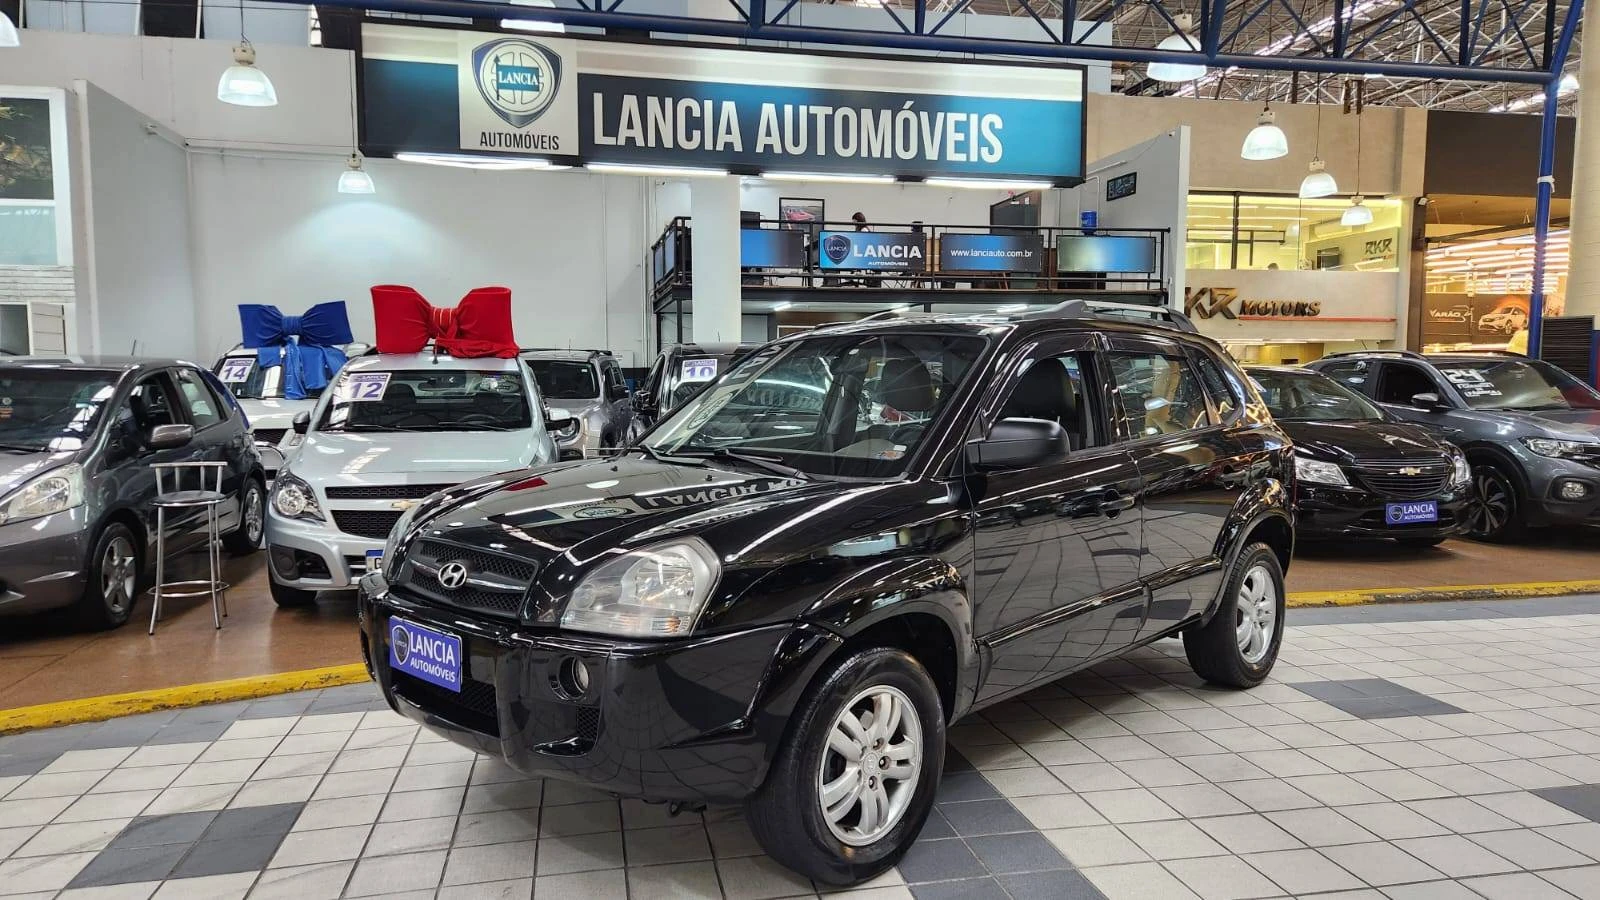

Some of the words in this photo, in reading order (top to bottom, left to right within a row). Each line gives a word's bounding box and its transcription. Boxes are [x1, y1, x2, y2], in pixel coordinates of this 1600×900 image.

[497, 70, 538, 85] LANCIA
[593, 92, 742, 152] LANCIA
[756, 100, 1003, 163] AUTOMÓVEIS
[480, 131, 560, 150] AUTOMÓVEIS
[853, 244, 922, 258] LANCIA
[950, 248, 1033, 257] www.lanciauto.com.br
[1239, 300, 1321, 316] MOTORS
[224, 367, 247, 380] 14
[687, 366, 714, 378] 10
[351, 382, 382, 398] 12
[1403, 504, 1434, 514] LANCIA
[410, 631, 456, 667] LANCIA
[410, 657, 456, 683] AUTOMÓVEIS
